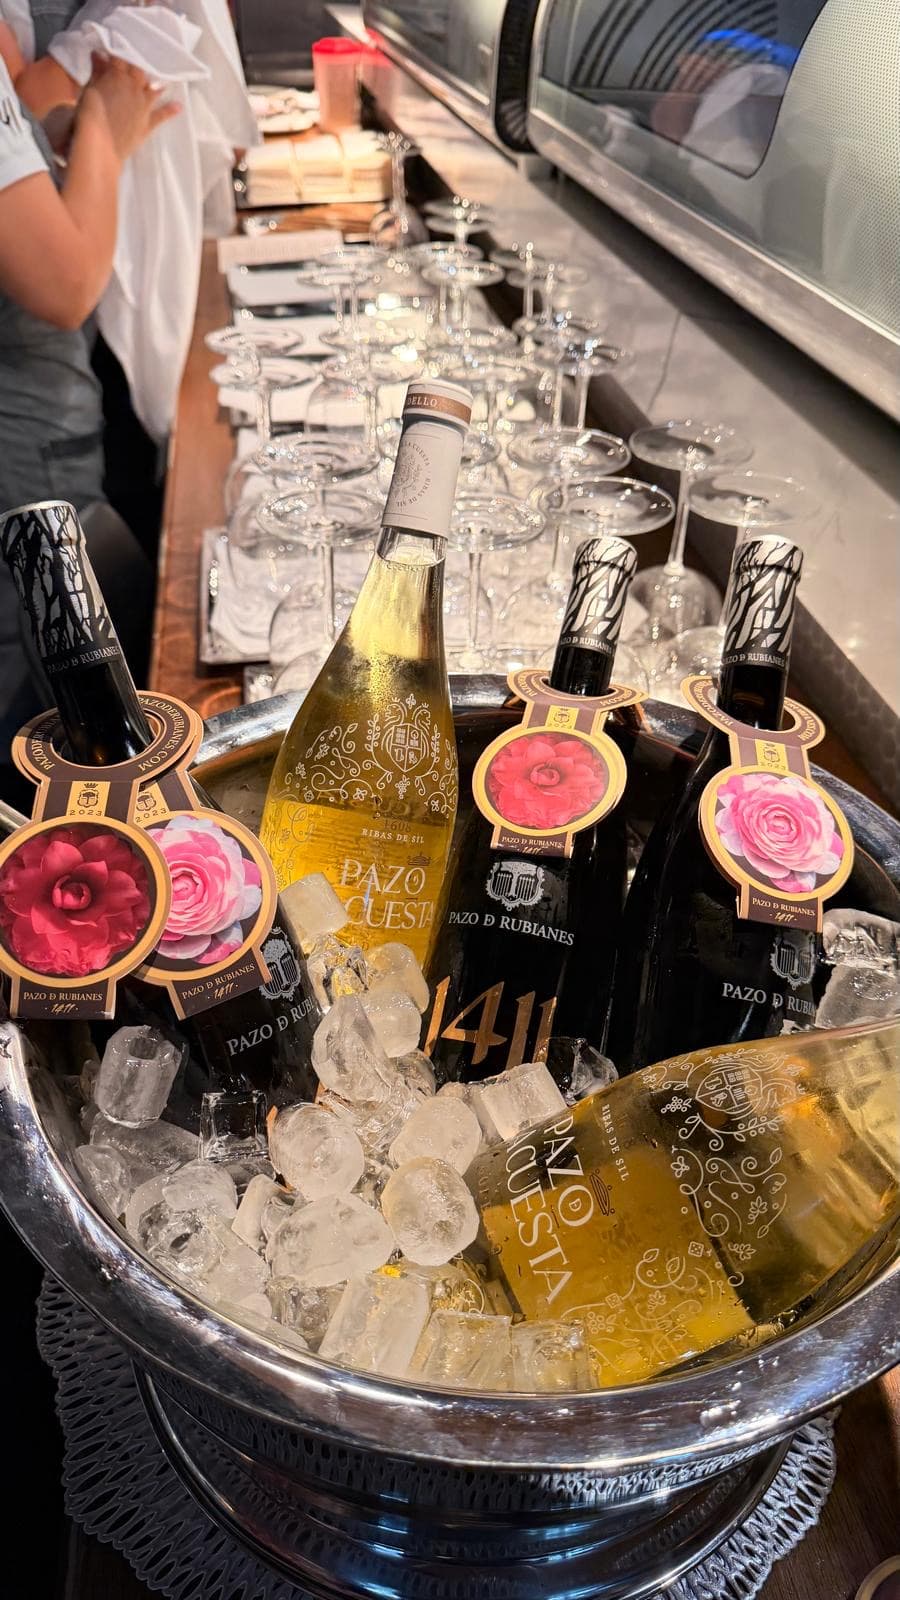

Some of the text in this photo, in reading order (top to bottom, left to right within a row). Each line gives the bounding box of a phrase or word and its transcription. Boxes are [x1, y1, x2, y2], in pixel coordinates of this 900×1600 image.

[69, 809, 103, 817] 2023
[135, 807, 168, 823] 2023
[362, 828, 424, 844] RIBAS DE SIL
[502, 836, 519, 844] PAZO
[528, 838, 564, 849] RUBIANES
[340, 857, 426, 895] PAZO
[345, 895, 435, 930] CUESTA
[752, 897, 771, 908] PAZO
[780, 903, 816, 917] RUBIANES
[449, 911, 479, 925] PAZO
[500, 915, 575, 946] RUBIANES
[23, 991, 47, 1000] PAZO
[59, 992, 103, 1001] RUBIANES
[181, 985, 204, 1000] PAZO
[214, 963, 255, 986] RUBIANES
[721, 982, 767, 1004] PAZO
[424, 975, 558, 1071] 1411
[226, 1024, 273, 1056] PAZO
[600, 1103, 629, 1182] RIBAS DE SIL
[543, 1115, 595, 1227] PAZO
[505, 1129, 573, 1304] ACUESTA
